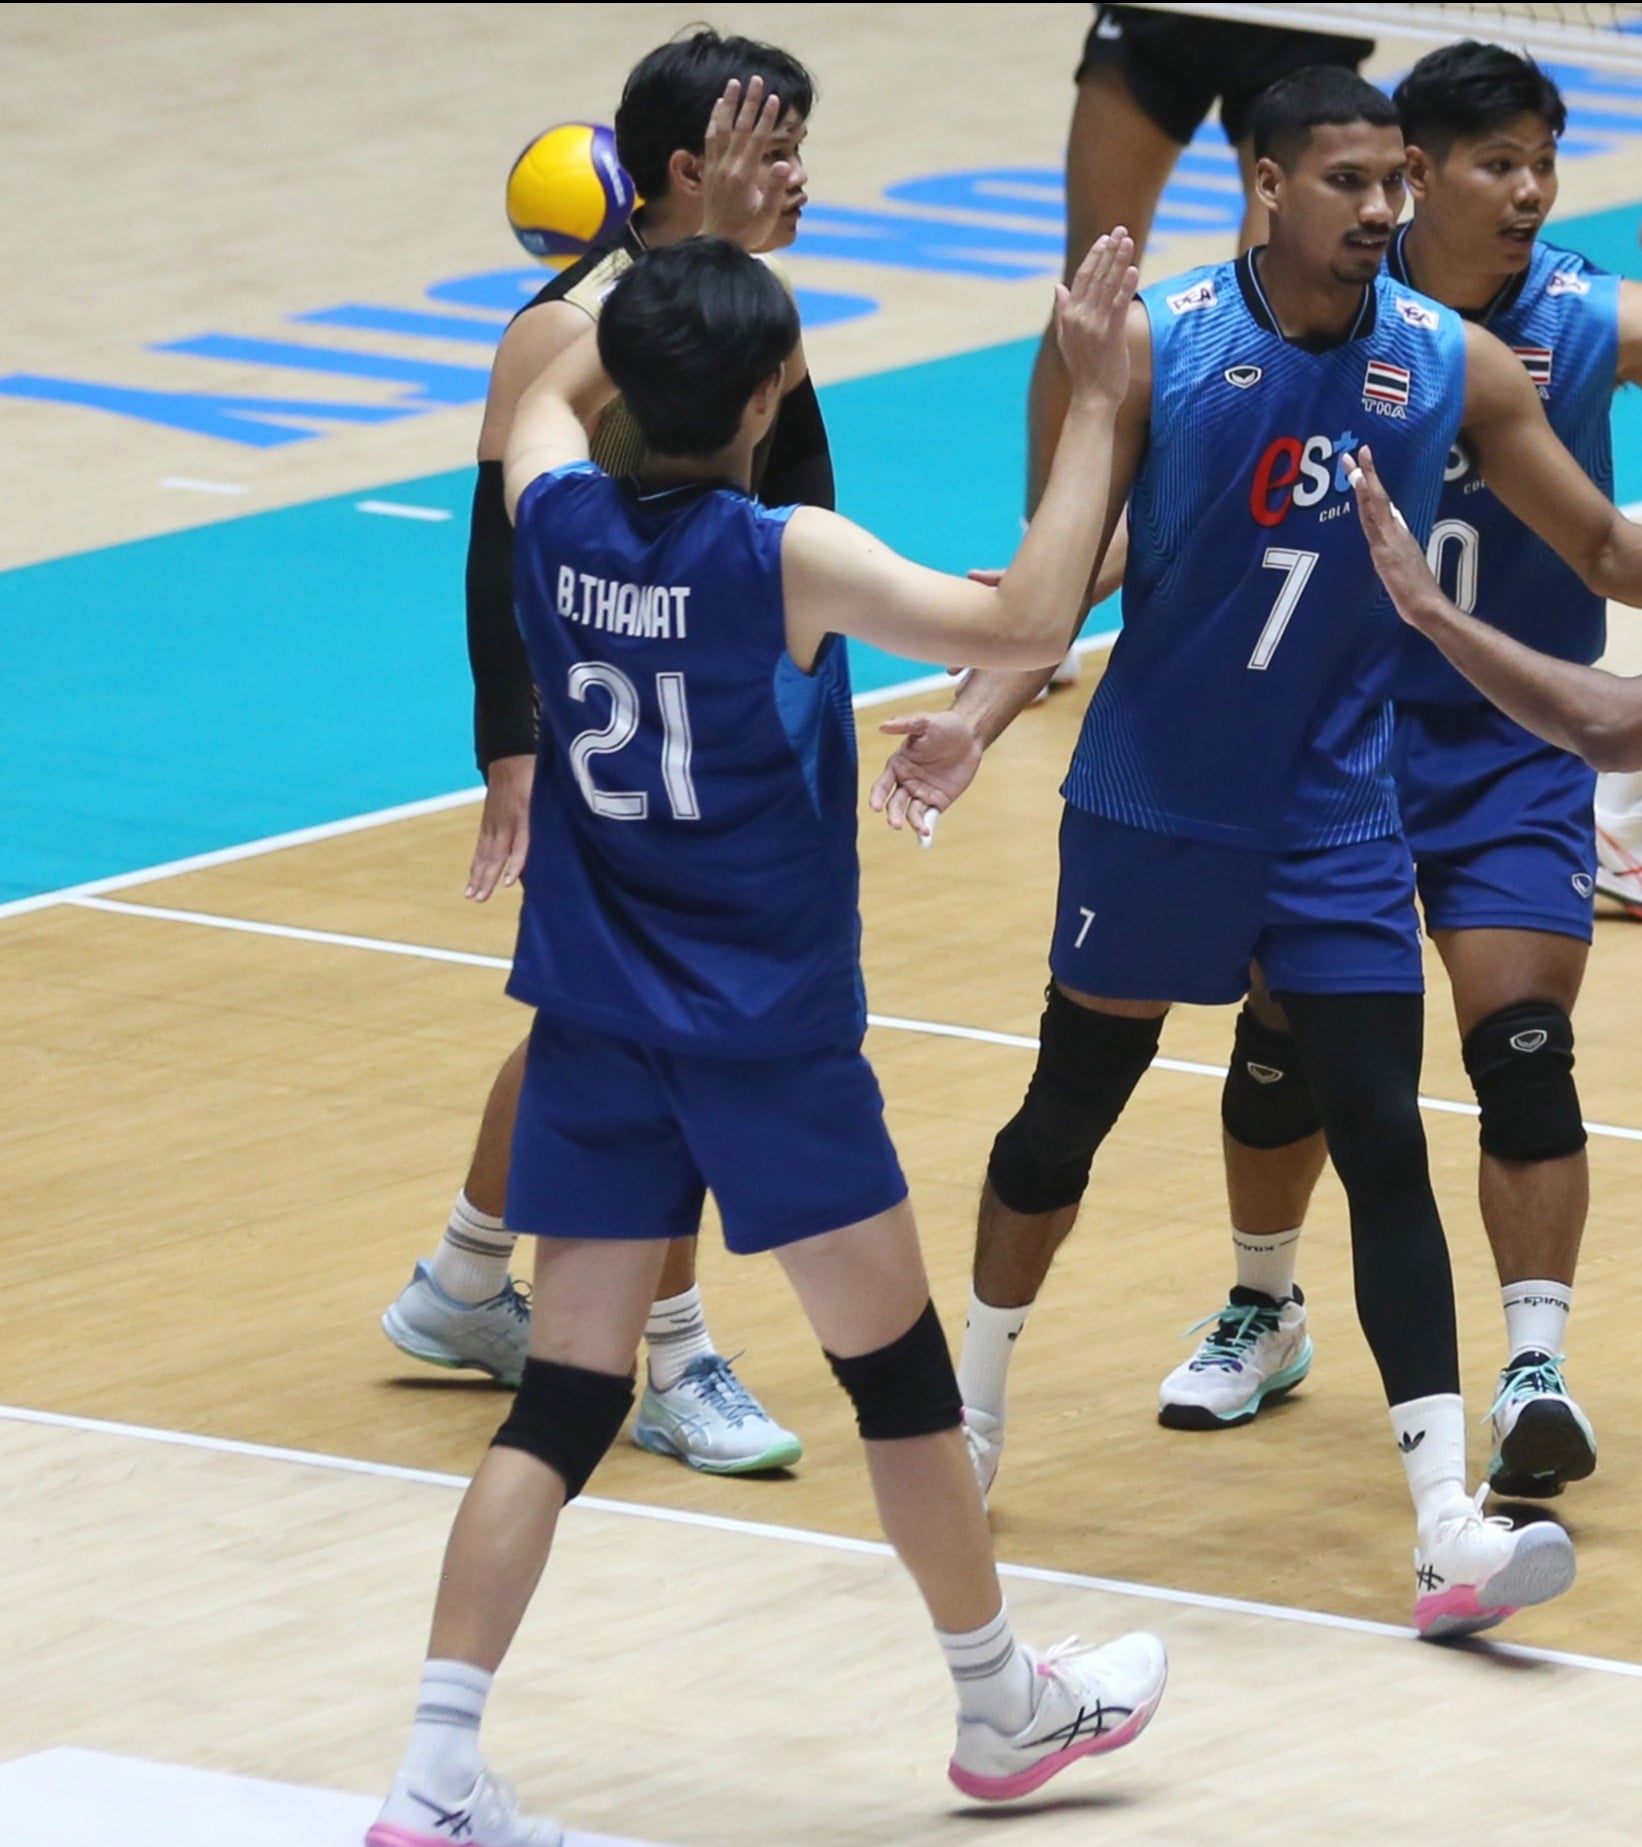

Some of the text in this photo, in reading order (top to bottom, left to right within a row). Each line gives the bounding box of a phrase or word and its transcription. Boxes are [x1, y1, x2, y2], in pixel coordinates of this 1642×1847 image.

[1361, 397, 1407, 420] THA
[1250, 430, 1359, 527] est
[1319, 502, 1351, 523] COLA
[556, 564, 691, 639] B.THANAT
[1247, 547, 1320, 670] 7
[567, 660, 701, 820] 21
[1074, 905, 1096, 949] 7
